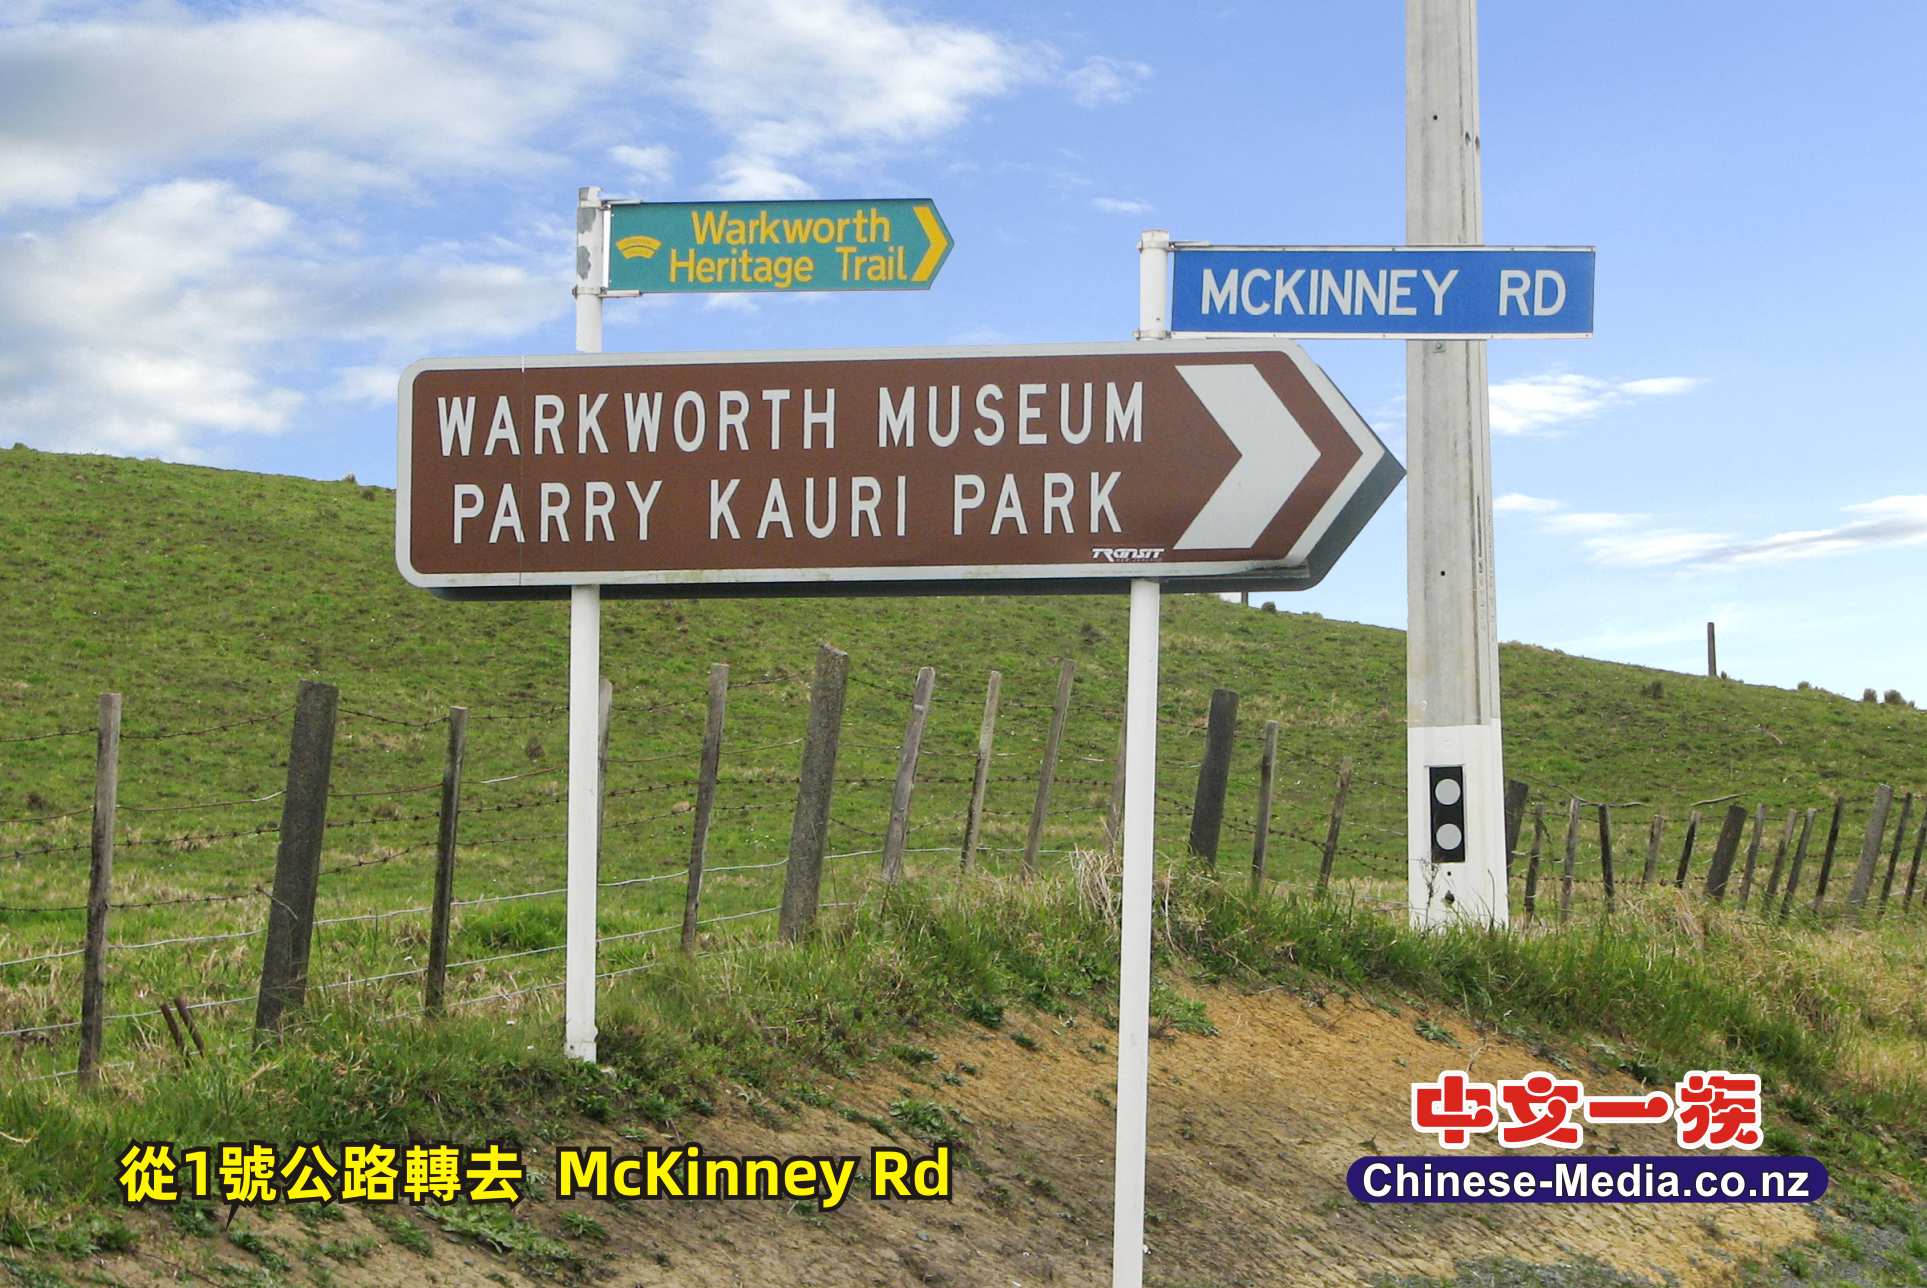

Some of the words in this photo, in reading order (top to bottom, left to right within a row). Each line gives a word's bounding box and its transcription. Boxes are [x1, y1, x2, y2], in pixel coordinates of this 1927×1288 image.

[691, 208, 890, 245] Warkworth
[669, 248, 815, 288] Heritage
[834, 246, 907, 281] Trail
[1201, 268, 1459, 316] MCKINNEY
[1499, 269, 1567, 316] RD
[437, 388, 836, 457] WARKWORTH
[878, 381, 1143, 448] MUSEUM
[453, 480, 662, 544] PARRY
[709, 475, 906, 541] KAURI
[953, 471, 1122, 536] PARK
